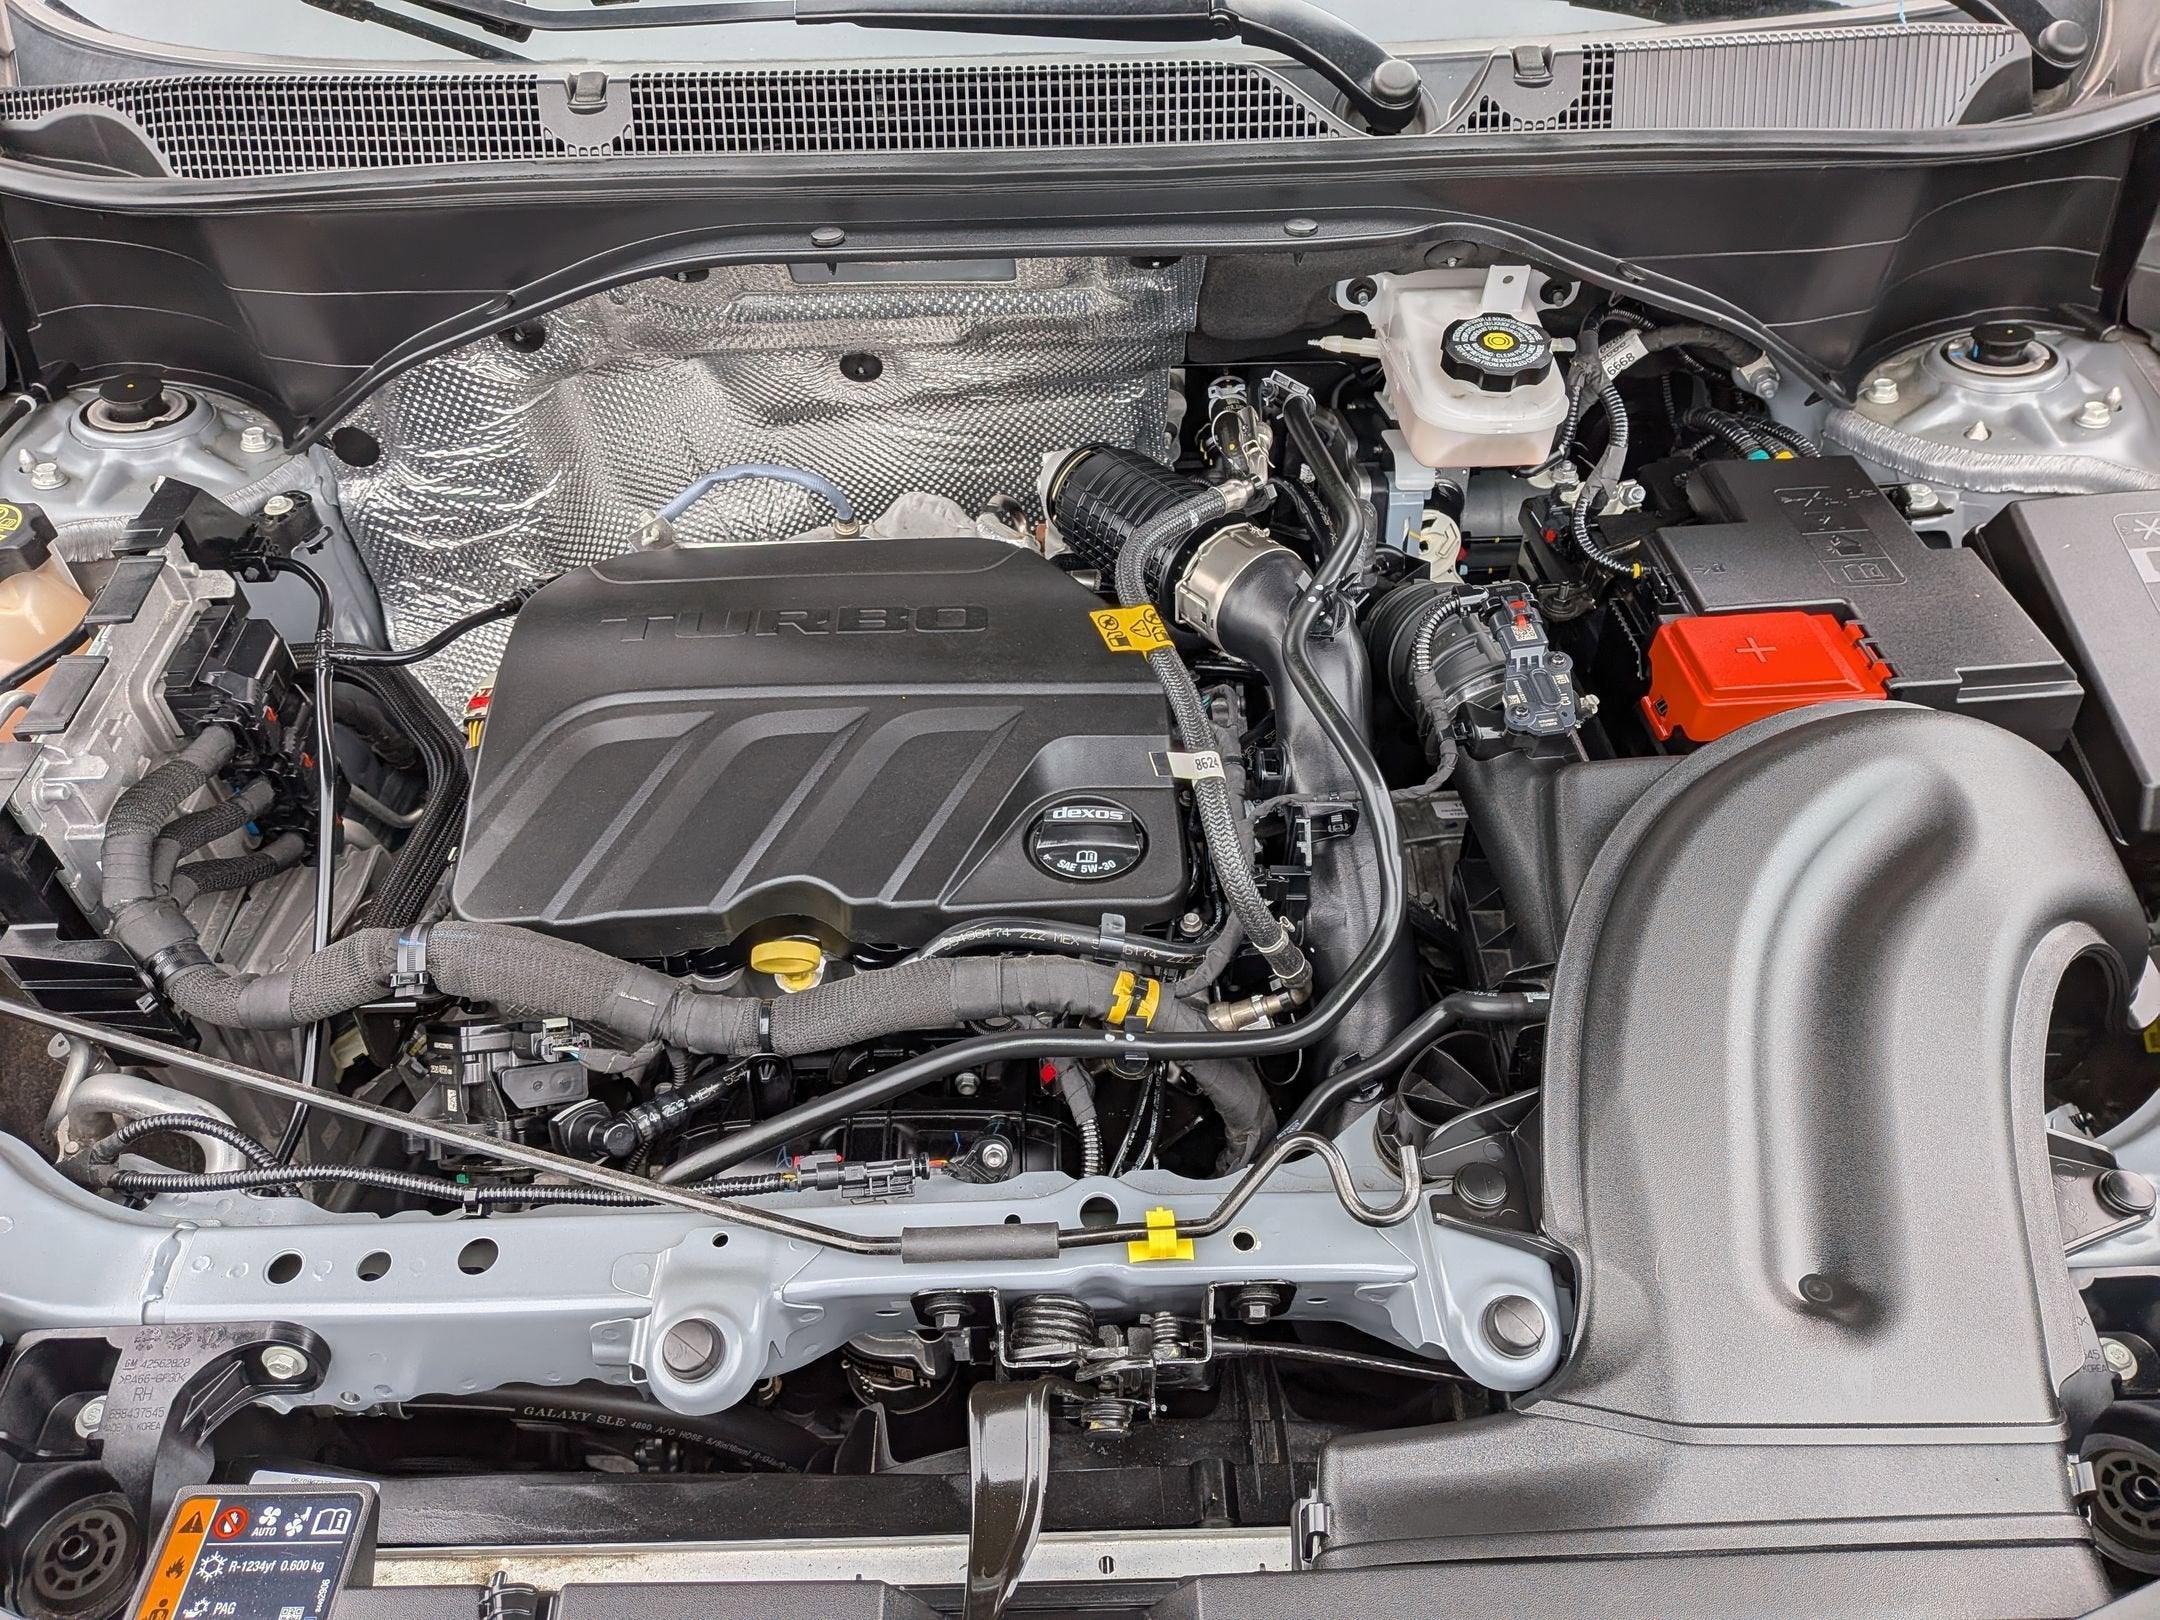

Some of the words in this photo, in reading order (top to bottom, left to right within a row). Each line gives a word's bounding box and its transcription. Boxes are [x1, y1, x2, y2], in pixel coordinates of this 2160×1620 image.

[1607, 352, 1635, 375] 6668
[601, 605, 989, 642] TURBO
[1195, 756, 1219, 771] 8624
[1052, 807, 1124, 821] dexos
[1057, 860, 1077, 872] SAE
[1080, 860, 1116, 874] 5W-30
[1053, 932, 1080, 946] MEX
[123, 1359, 138, 1370] GM
[133, 1386, 154, 1402] RH
[136, 1421, 162, 1431] KOREA
[524, 1406, 592, 1422] GALAXY
[596, 1414, 627, 1427] SLE
[655, 1426, 676, 1436] A/C
[679, 1430, 704, 1442] HOSE
[252, 1527, 277, 1537] AUTO
[228, 1560, 276, 1574] R-1234yf
[280, 1560, 310, 1572] 0.600
[310, 1560, 325, 1573] kg
[213, 1602, 237, 1615] PAG
